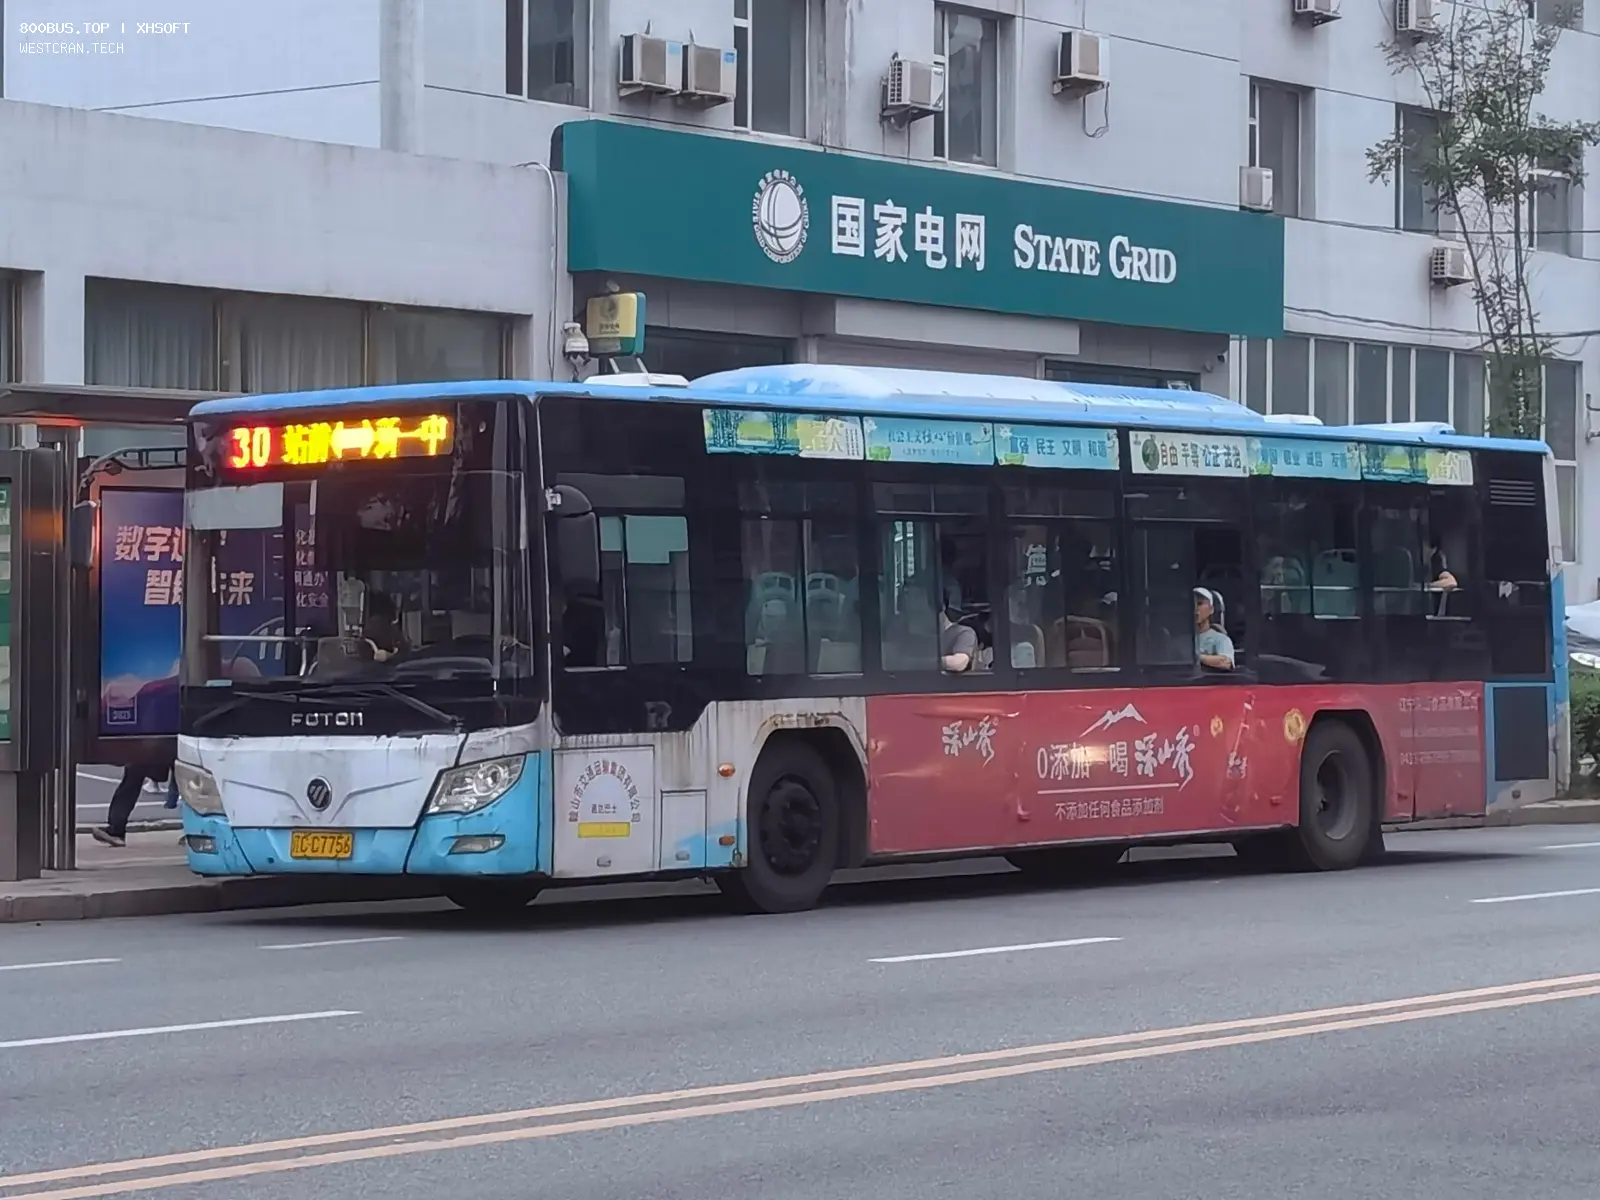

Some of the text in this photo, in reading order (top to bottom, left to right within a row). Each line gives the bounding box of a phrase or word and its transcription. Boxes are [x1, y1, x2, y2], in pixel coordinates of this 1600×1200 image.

[831, 195, 985, 271] 国家电网
[1013, 223, 1177, 284] STATE GRID
[232, 427, 271, 468] 30
[291, 711, 363, 727] FOTON
[1054, 795, 1164, 821] 不添加任何食品添加剂
